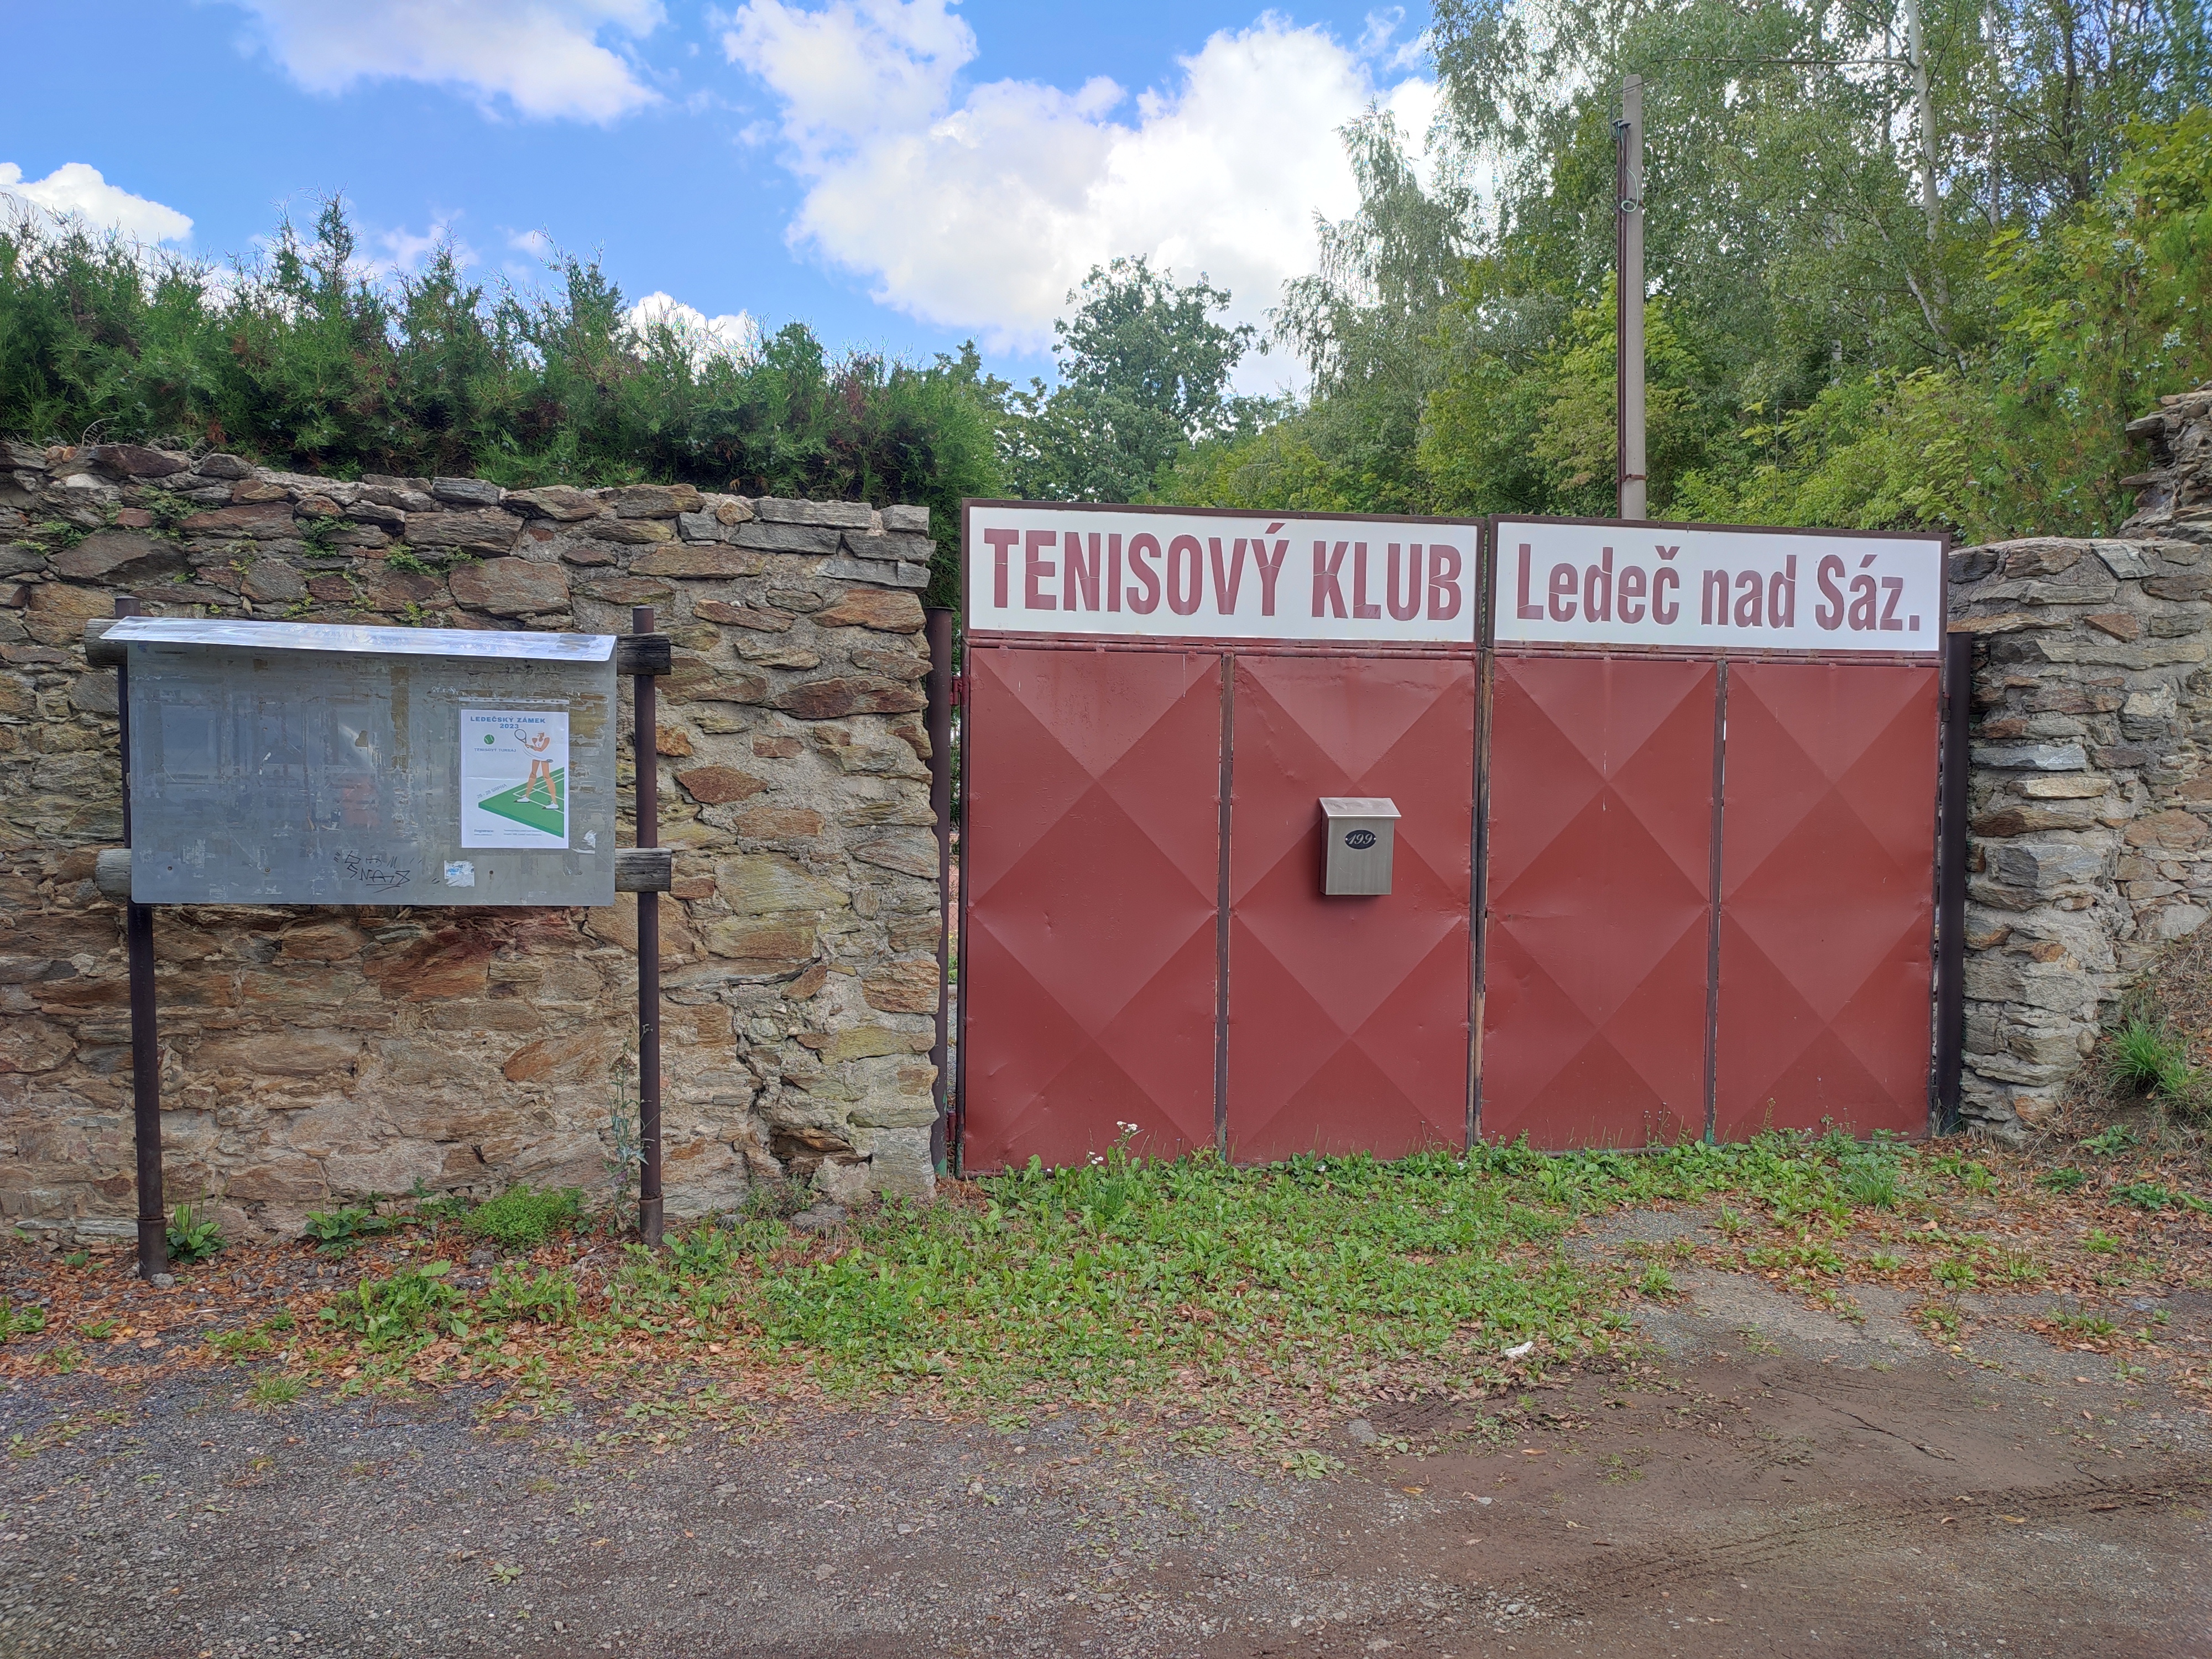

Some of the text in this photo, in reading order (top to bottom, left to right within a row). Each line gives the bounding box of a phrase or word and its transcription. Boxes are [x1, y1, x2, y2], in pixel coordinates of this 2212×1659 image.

[984, 522, 1463, 621] TENISOVÝ KLUB
[1517, 543, 1921, 632] Ledeč nad Sáz.
[1348, 833, 1373, 844] 199
